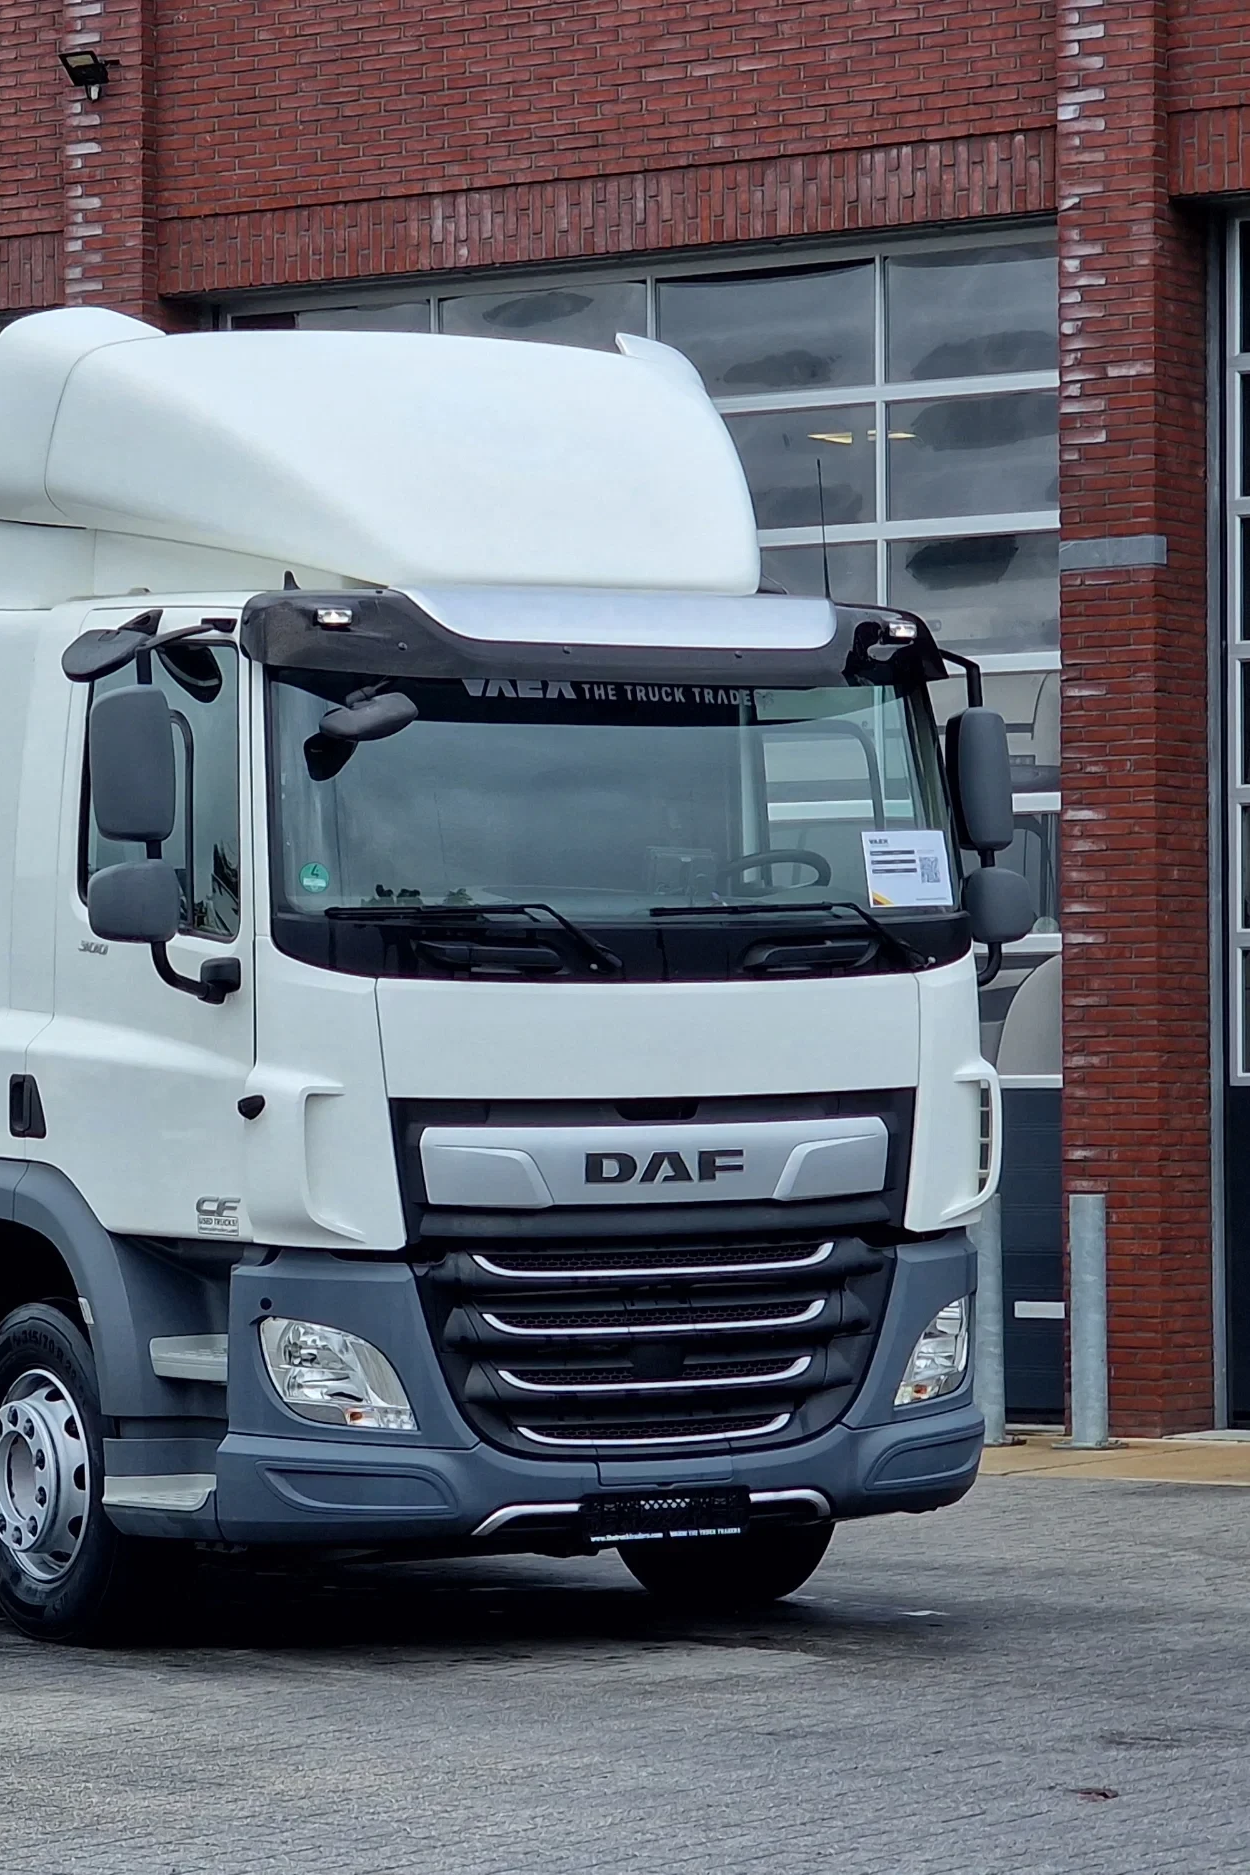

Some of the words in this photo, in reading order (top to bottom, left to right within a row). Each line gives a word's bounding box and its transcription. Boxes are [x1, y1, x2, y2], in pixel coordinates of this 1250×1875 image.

[581, 683, 617, 701] THE
[623, 685, 685, 703] TRUCK
[585, 1149, 744, 1183] DAF
[196, 1196, 241, 1216] CF
